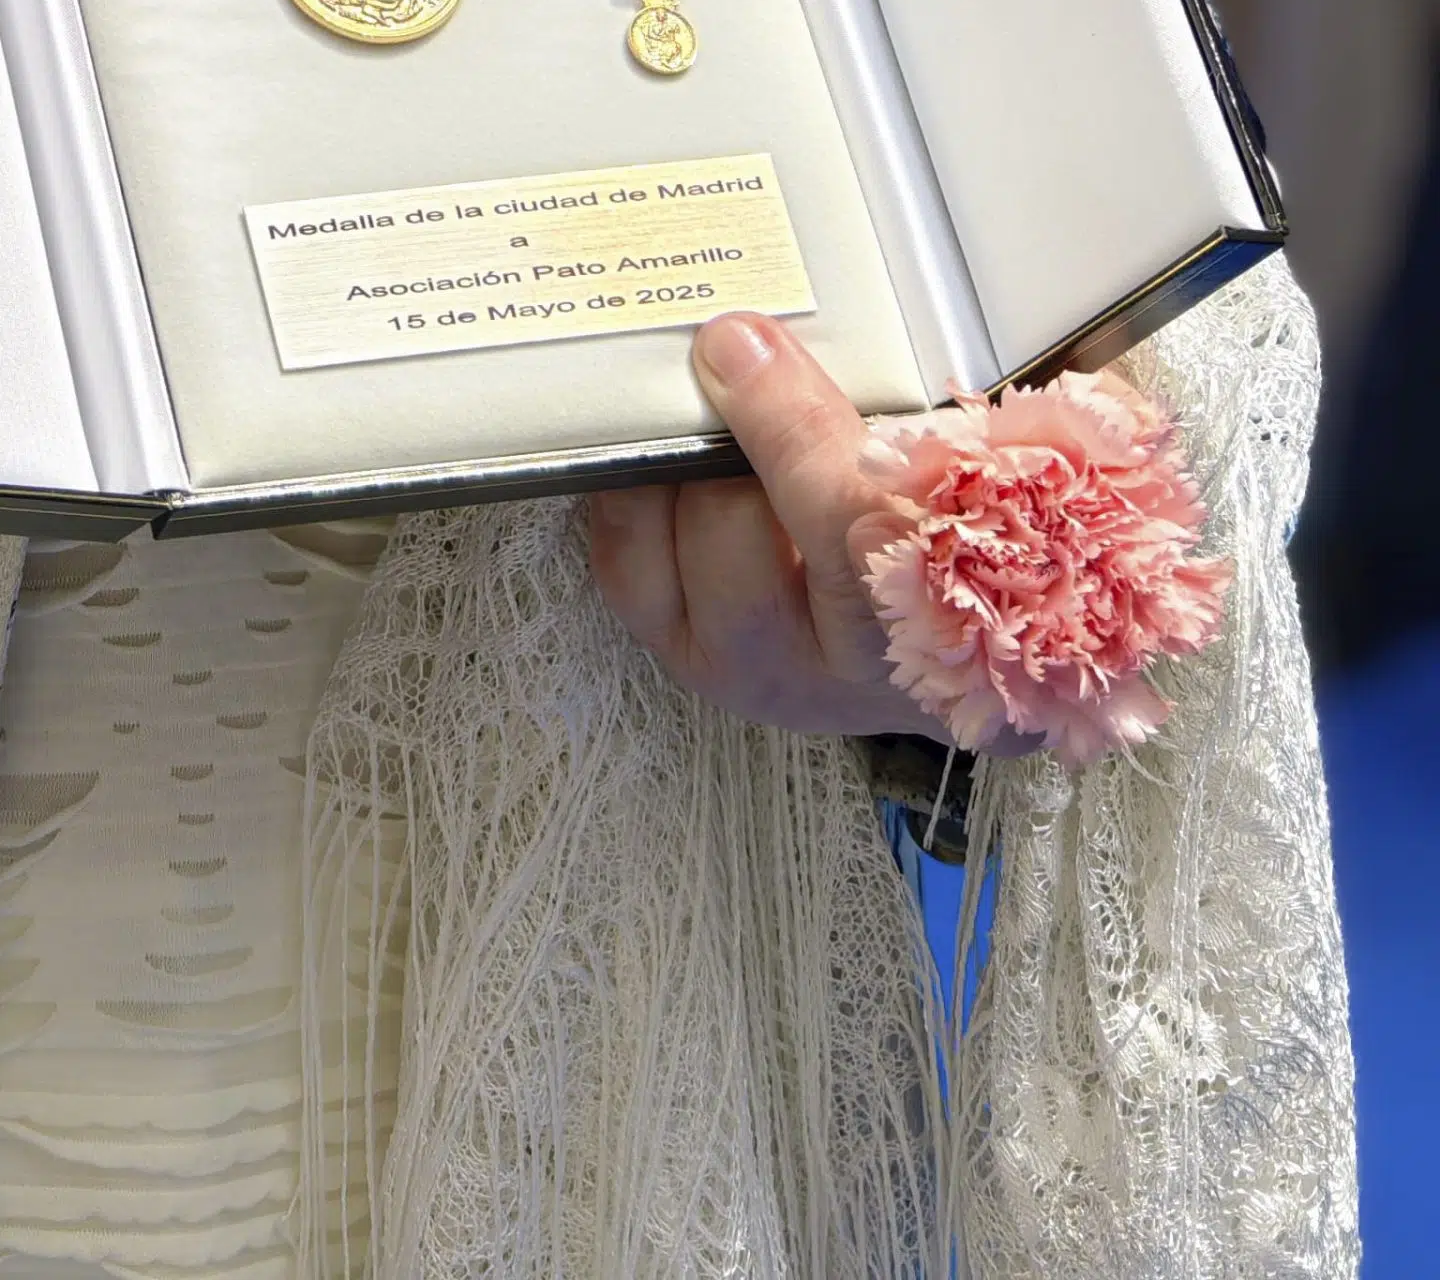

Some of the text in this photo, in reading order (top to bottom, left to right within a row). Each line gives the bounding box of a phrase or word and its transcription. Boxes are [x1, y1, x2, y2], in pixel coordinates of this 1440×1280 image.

[268, 176, 763, 240] Medalla de la ciudad de Madrid
[510, 236, 529, 248] a
[347, 247, 743, 301] Asociación Pato Amarillo
[388, 283, 715, 331] 15 de Mayo de 2025
